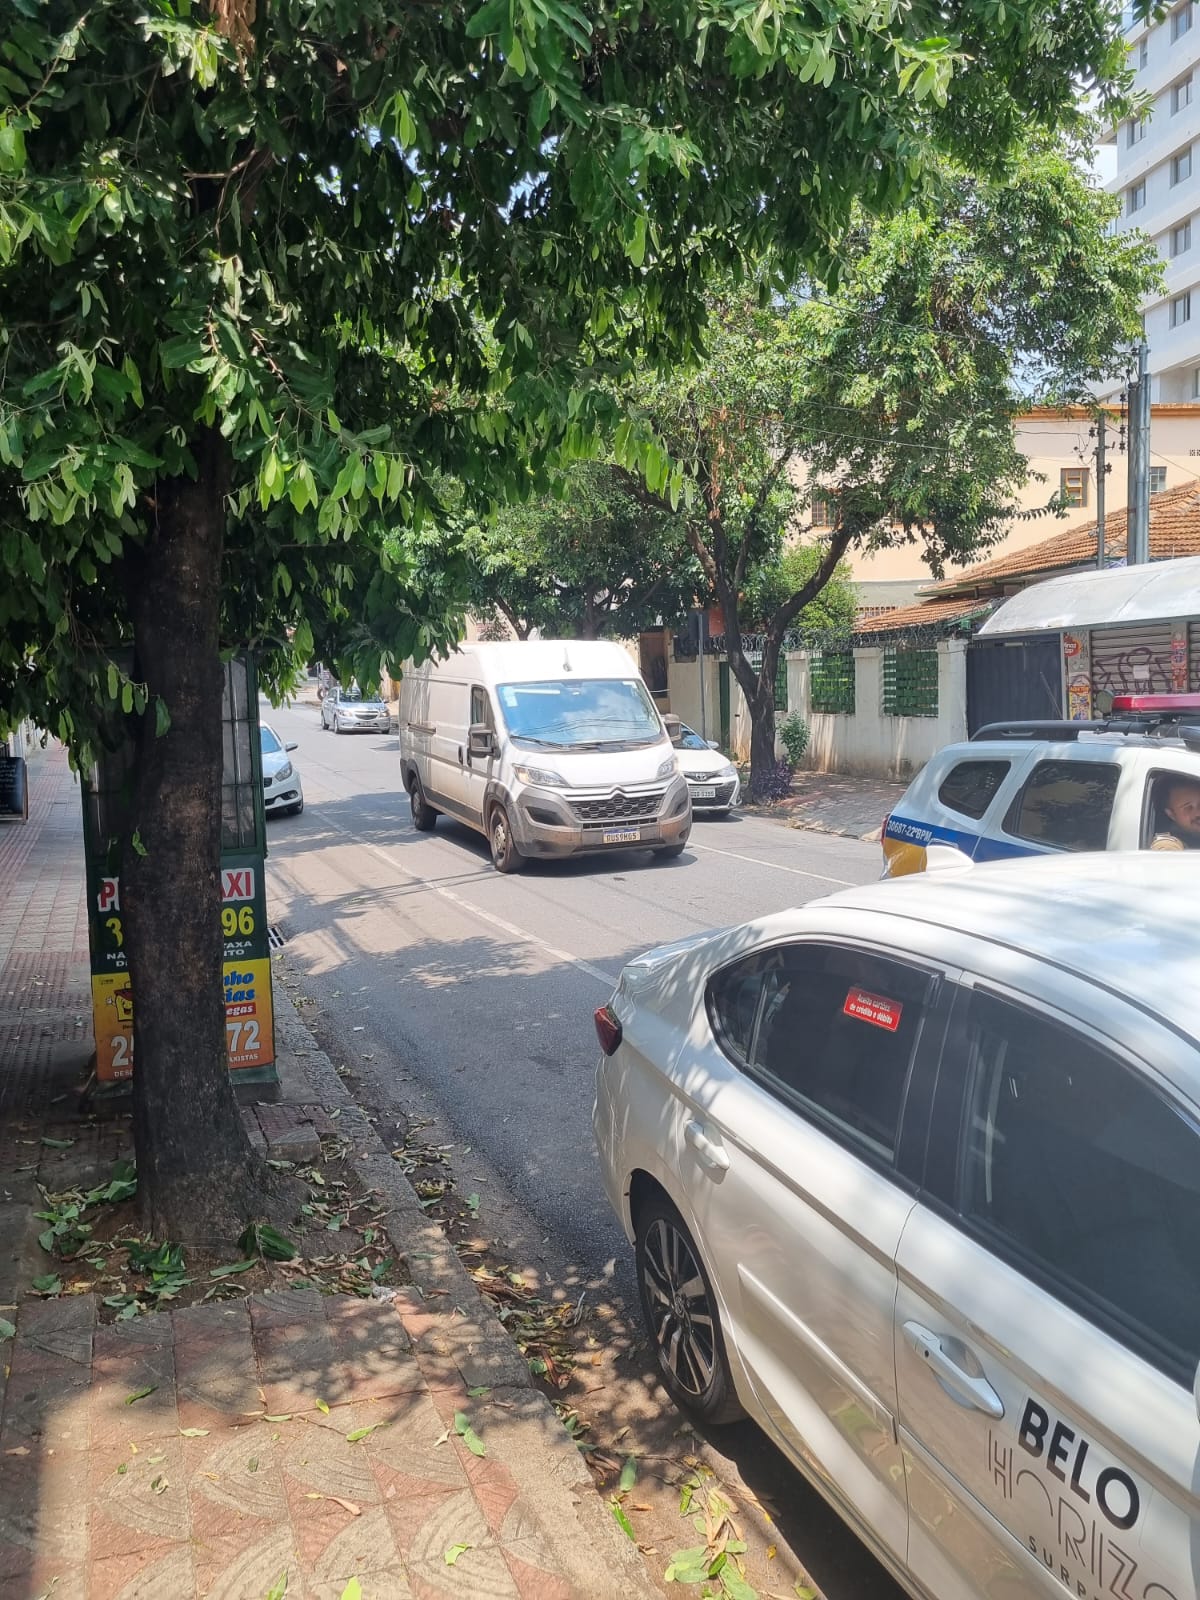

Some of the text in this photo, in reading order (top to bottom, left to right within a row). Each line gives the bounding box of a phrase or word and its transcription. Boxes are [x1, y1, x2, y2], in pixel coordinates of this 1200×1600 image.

[221, 906, 255, 937] 96
[226, 1005, 254, 1016] egas
[226, 1020, 261, 1052] 72
[1018, 1397, 1140, 1530] BELO
